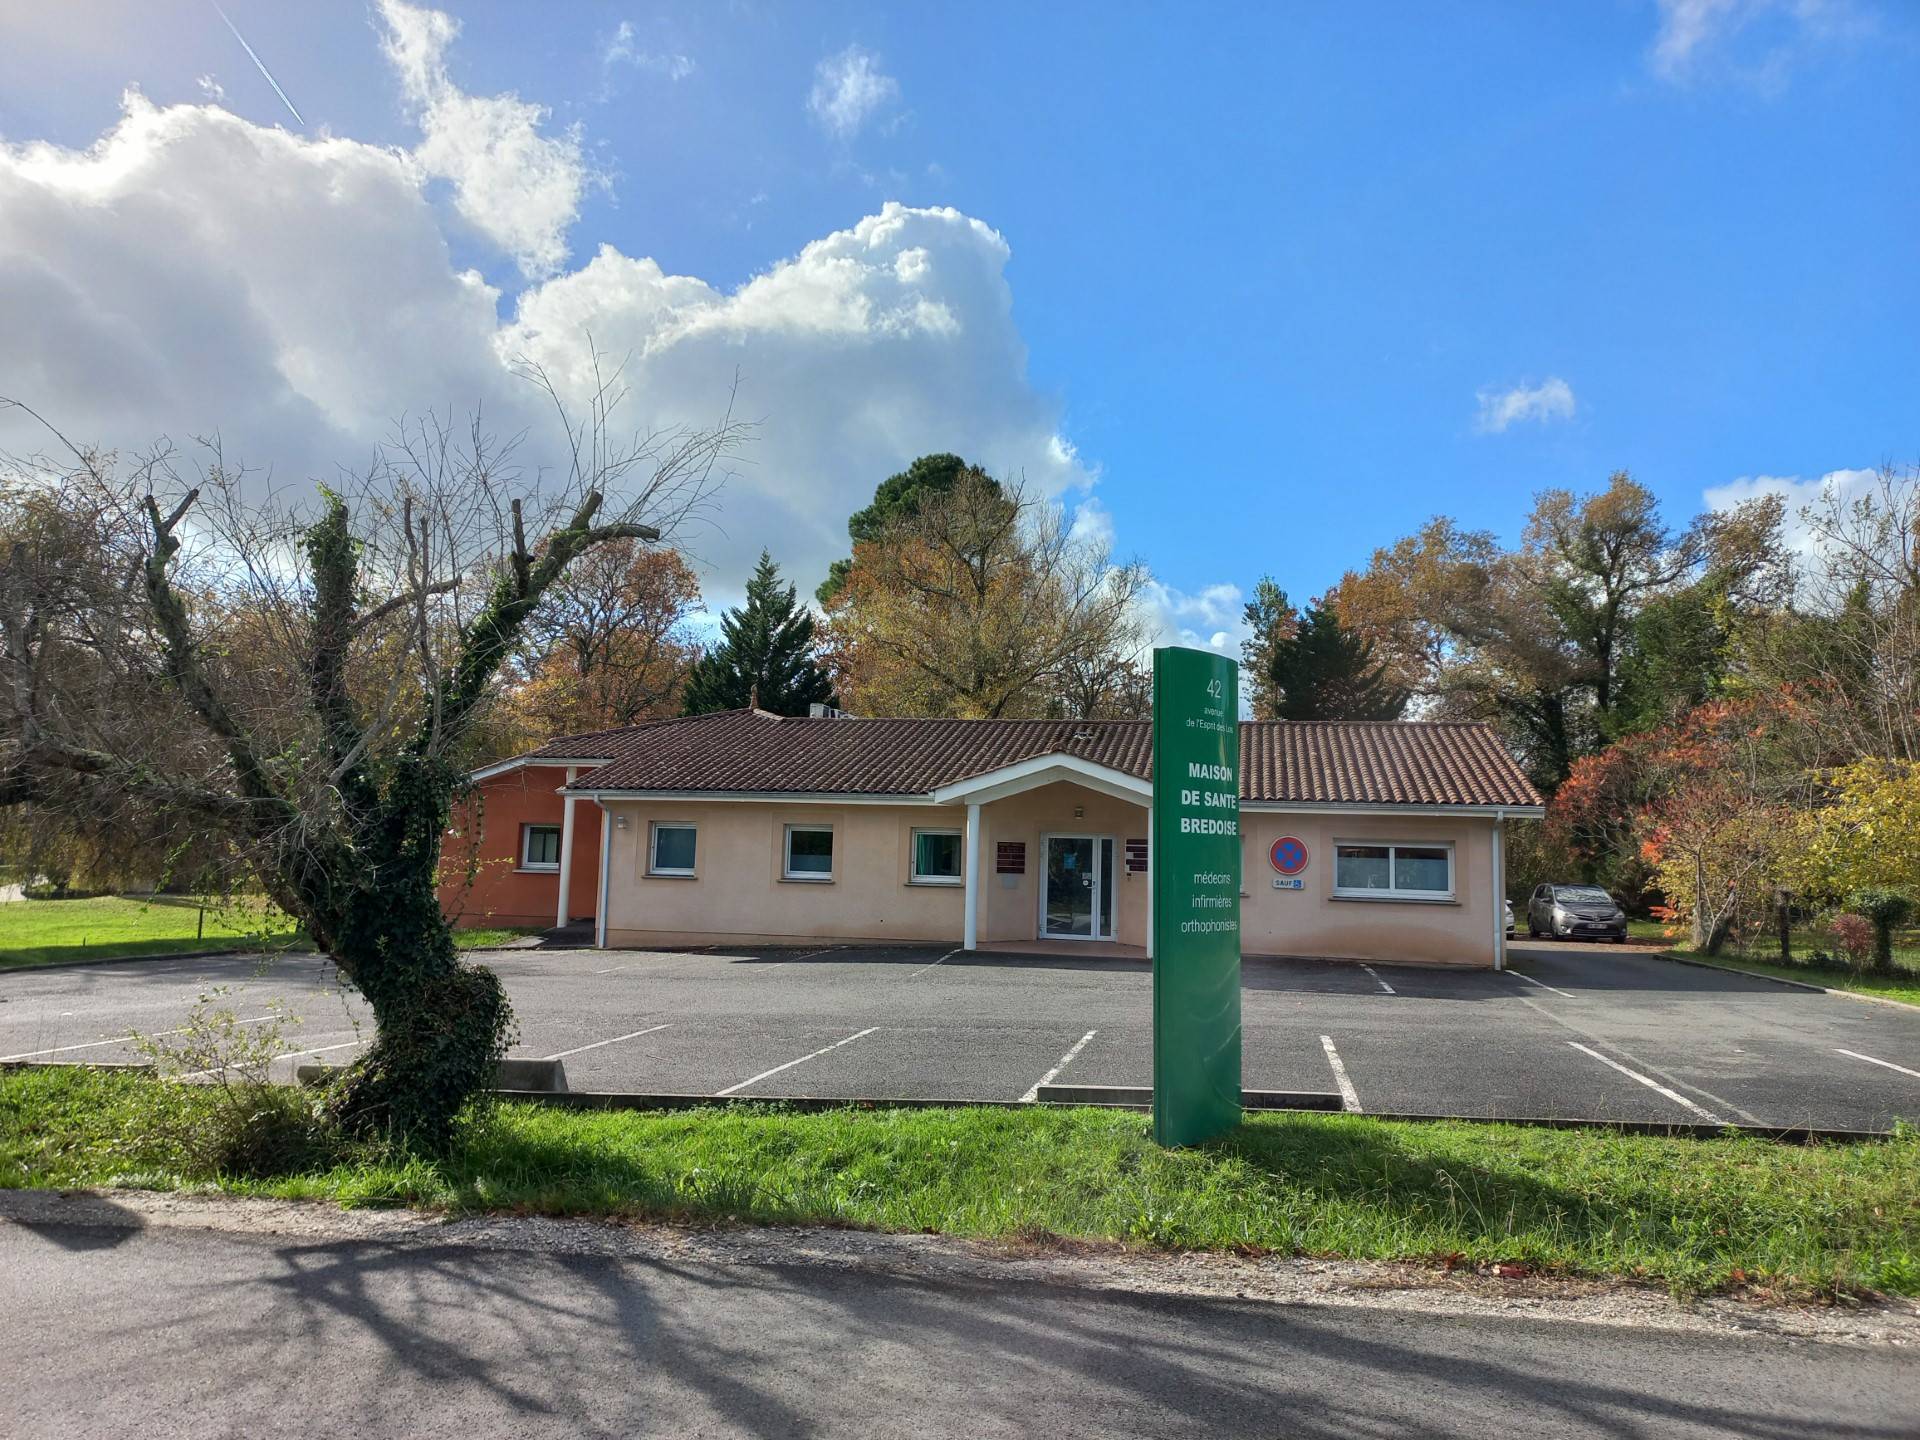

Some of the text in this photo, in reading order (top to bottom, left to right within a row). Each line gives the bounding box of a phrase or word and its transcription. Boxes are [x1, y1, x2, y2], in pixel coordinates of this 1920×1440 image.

[1206, 679, 1222, 698] 42
[1204, 707, 1224, 717] avenue
[1186, 717, 1195, 727] de
[1188, 762, 1233, 782] MAISON
[1181, 789, 1237, 809] DE SANTE
[1180, 817, 1237, 836] BREDOISE
[1194, 871, 1231, 885] médecins
[1192, 894, 1232, 908] infirmières
[1181, 919, 1237, 934] orthophonistes
